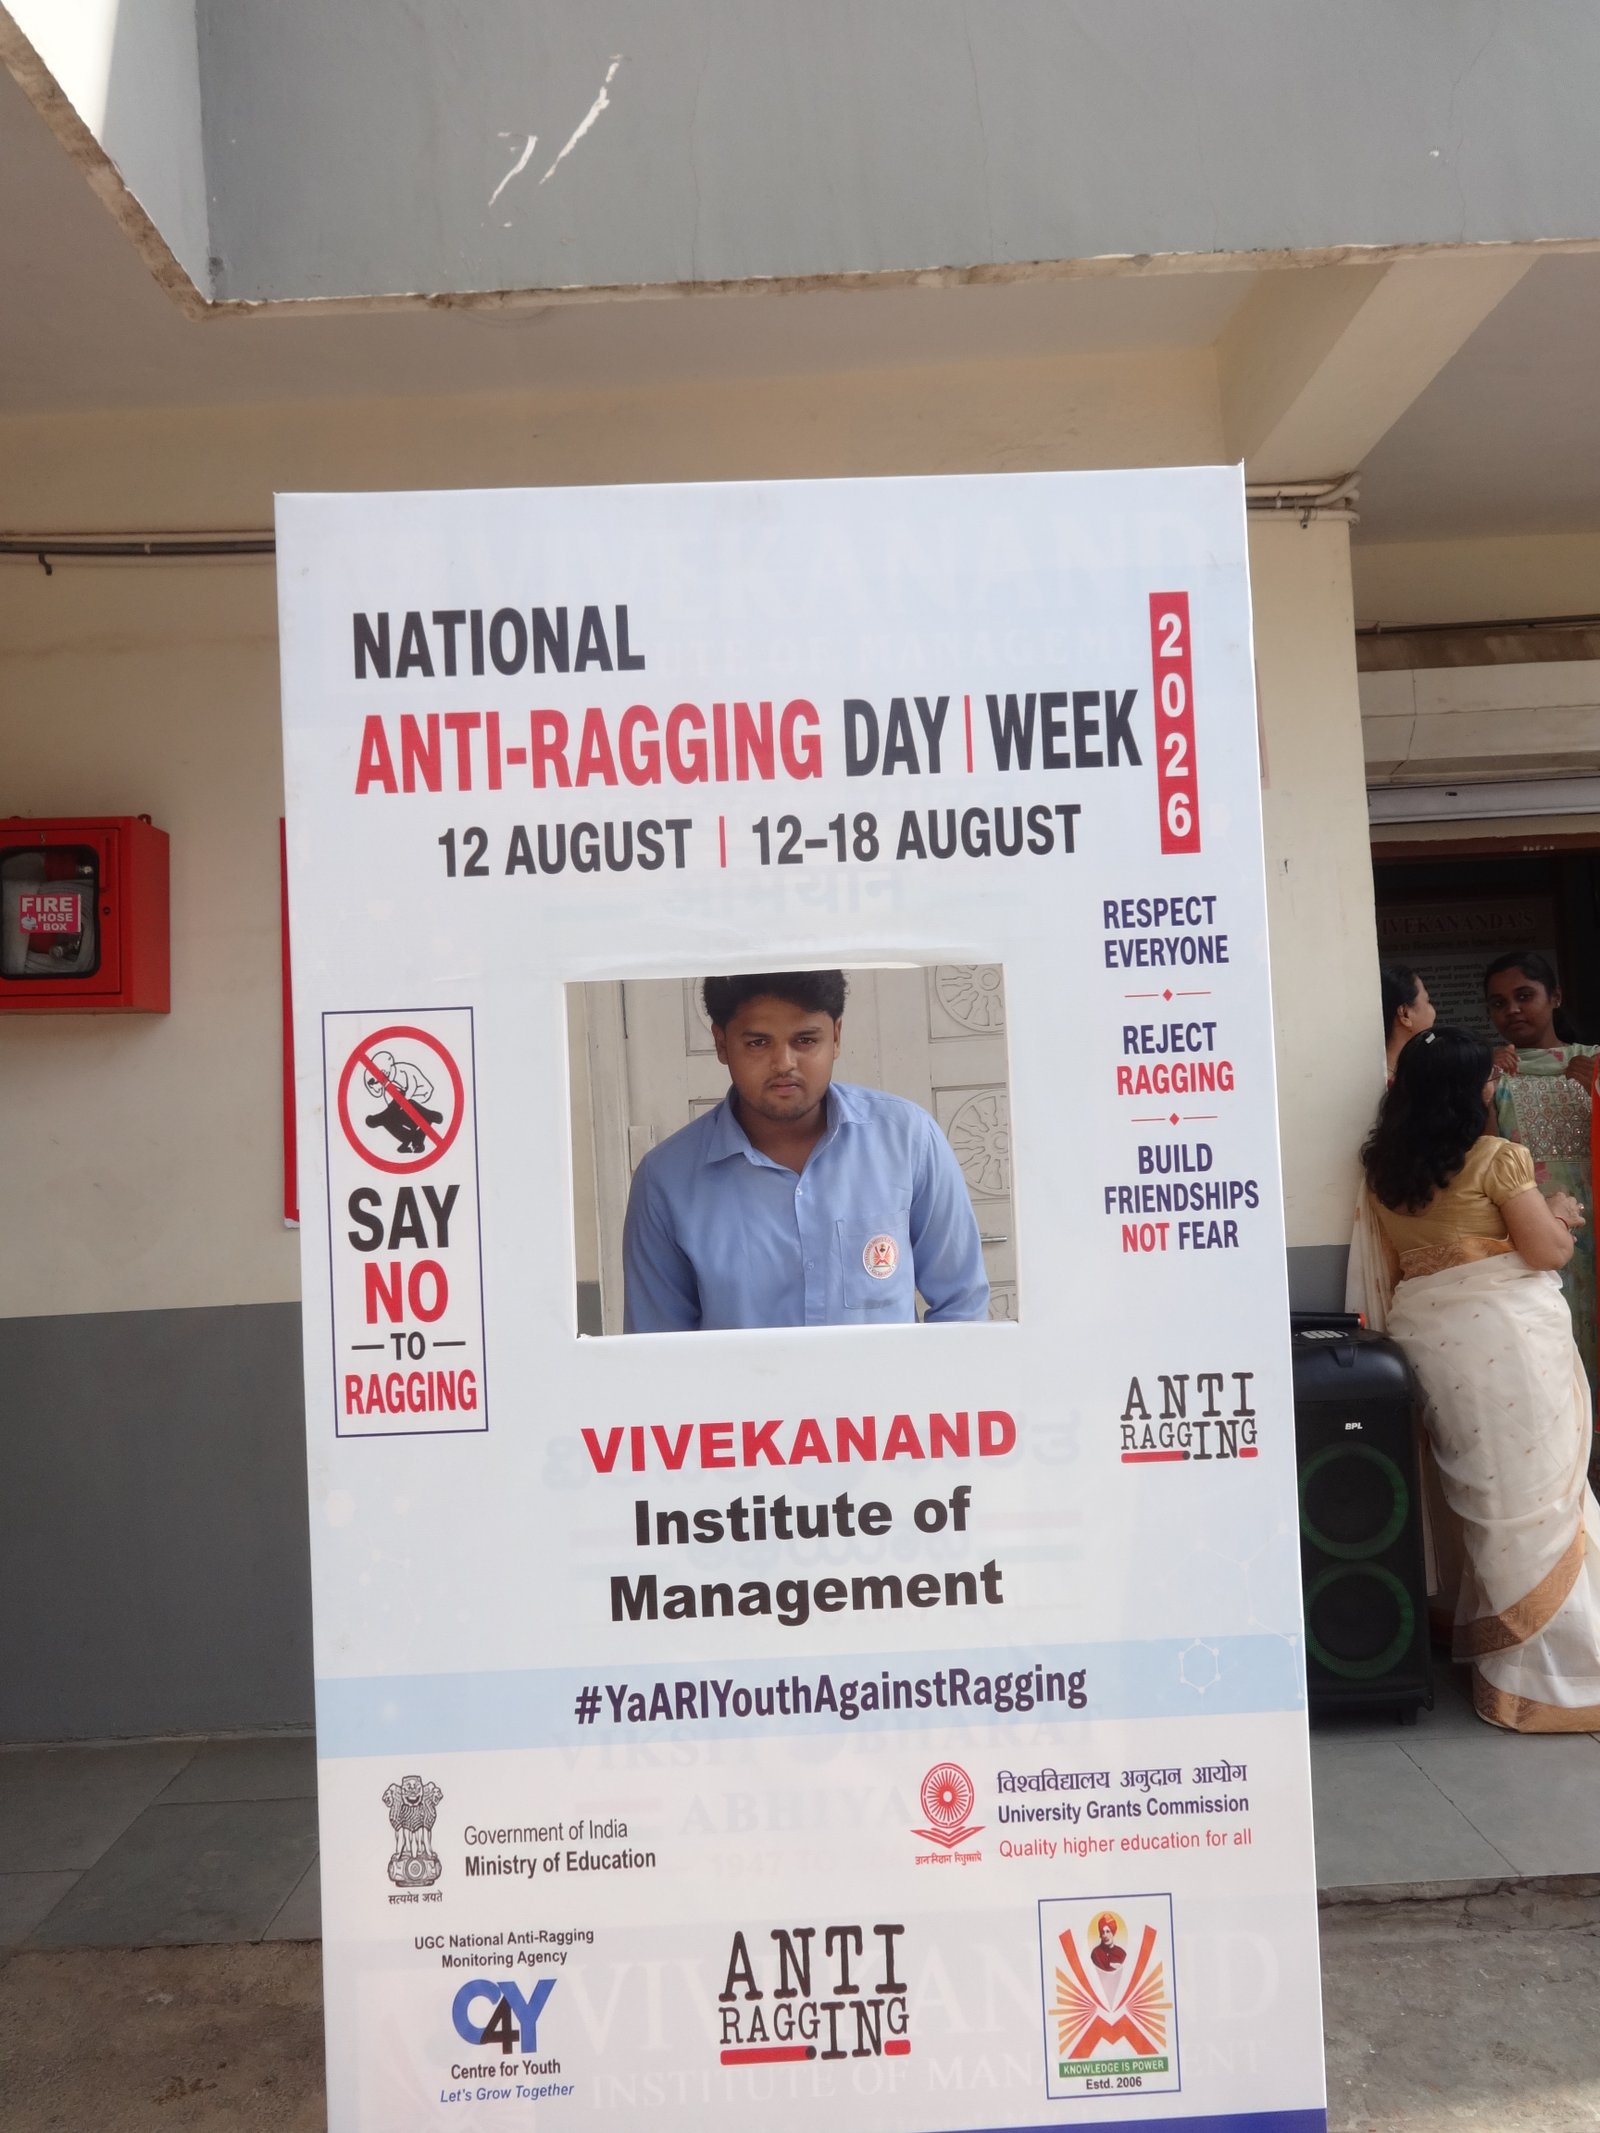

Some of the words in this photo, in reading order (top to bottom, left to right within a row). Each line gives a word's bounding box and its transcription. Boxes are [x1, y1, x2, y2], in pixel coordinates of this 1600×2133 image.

[353, 605, 645, 679] NATIONAL
[355, 699, 822, 794] ANTI-RAGGING
[844, 696, 950, 777] DAY
[986, 689, 1142, 771] WEEK
[1156, 612, 1193, 839] 2026
[438, 827, 489, 877] 12
[505, 819, 692, 875] AUGUST
[896, 804, 1081, 860] AUGUST
[22, 897, 73, 912] FIRE
[38, 913, 73, 922] HOSE
[1104, 896, 1216, 929] RESPECT
[1380, 911, 1536, 935] IVEKANANDA'S
[1105, 935, 1229, 968] EVERYONE
[1123, 1022, 1217, 1054] REJECT
[1117, 1061, 1234, 1095] RAGGING
[1138, 1143, 1212, 1174] BUILD
[1105, 1180, 1259, 1214] FRIENDSHIPS
[348, 1185, 460, 1252] SAY
[1122, 1223, 1169, 1252] NOT
[1179, 1220, 1239, 1250] FEAR
[365, 1260, 448, 1324] NO
[390, 1331, 425, 1360] TO
[345, 1369, 477, 1415] RAGGING
[1120, 1372, 1256, 1420] ANTI
[581, 1411, 1016, 1473] VIVEKANAND
[1120, 1418, 1258, 1461] RAGGING
[1345, 1422, 1362, 1430] BPL
[635, 1492, 892, 1546] Institute
[914, 1485, 971, 1533] of
[610, 1559, 1003, 1626] Management
[1120, 1768, 1182, 1793] अनुदान
[1192, 1760, 1247, 1784] आयोग
[999, 1802, 1081, 1824] University
[1087, 1800, 1141, 1819] Grants
[1147, 1794, 1248, 1816] Commission
[464, 1823, 564, 1845] Government
[569, 1820, 584, 1840] of
[590, 1819, 627, 1839] India
[1000, 1839, 1057, 1859] Quality
[1064, 1836, 1115, 1857] higher
[1121, 1832, 1199, 1851] education
[1206, 1830, 1227, 1846] for
[1234, 1828, 1251, 1845] all
[466, 1855, 537, 1879] Ministry
[543, 1852, 560, 1872] of
[567, 1848, 655, 1871] Education
[415, 1936, 444, 1949] UGC
[450, 1933, 503, 1947] National
[507, 1929, 594, 1945] Anti-Ragging
[442, 1952, 513, 1968] Monitoring
[517, 1951, 567, 1967] Agency
[719, 1924, 908, 2002] ANTI
[452, 1979, 557, 2054] C4Y
[718, 1997, 910, 2060] RAGGING
[451, 2064, 496, 2079] Centre
[500, 2061, 519, 2076] for
[522, 2059, 560, 2075] Youth
[1064, 2063, 1119, 2074] KNOWLEDGE
[1122, 2062, 1130, 2071] IS
[1133, 2060, 1164, 2070] POWER
[1086, 2078, 1113, 2090] Estd.
[1117, 2076, 1142, 2088] 2006
[440, 2089, 472, 2102] Let's
[477, 2088, 511, 2100] Grow
[516, 2083, 574, 2100] Together
